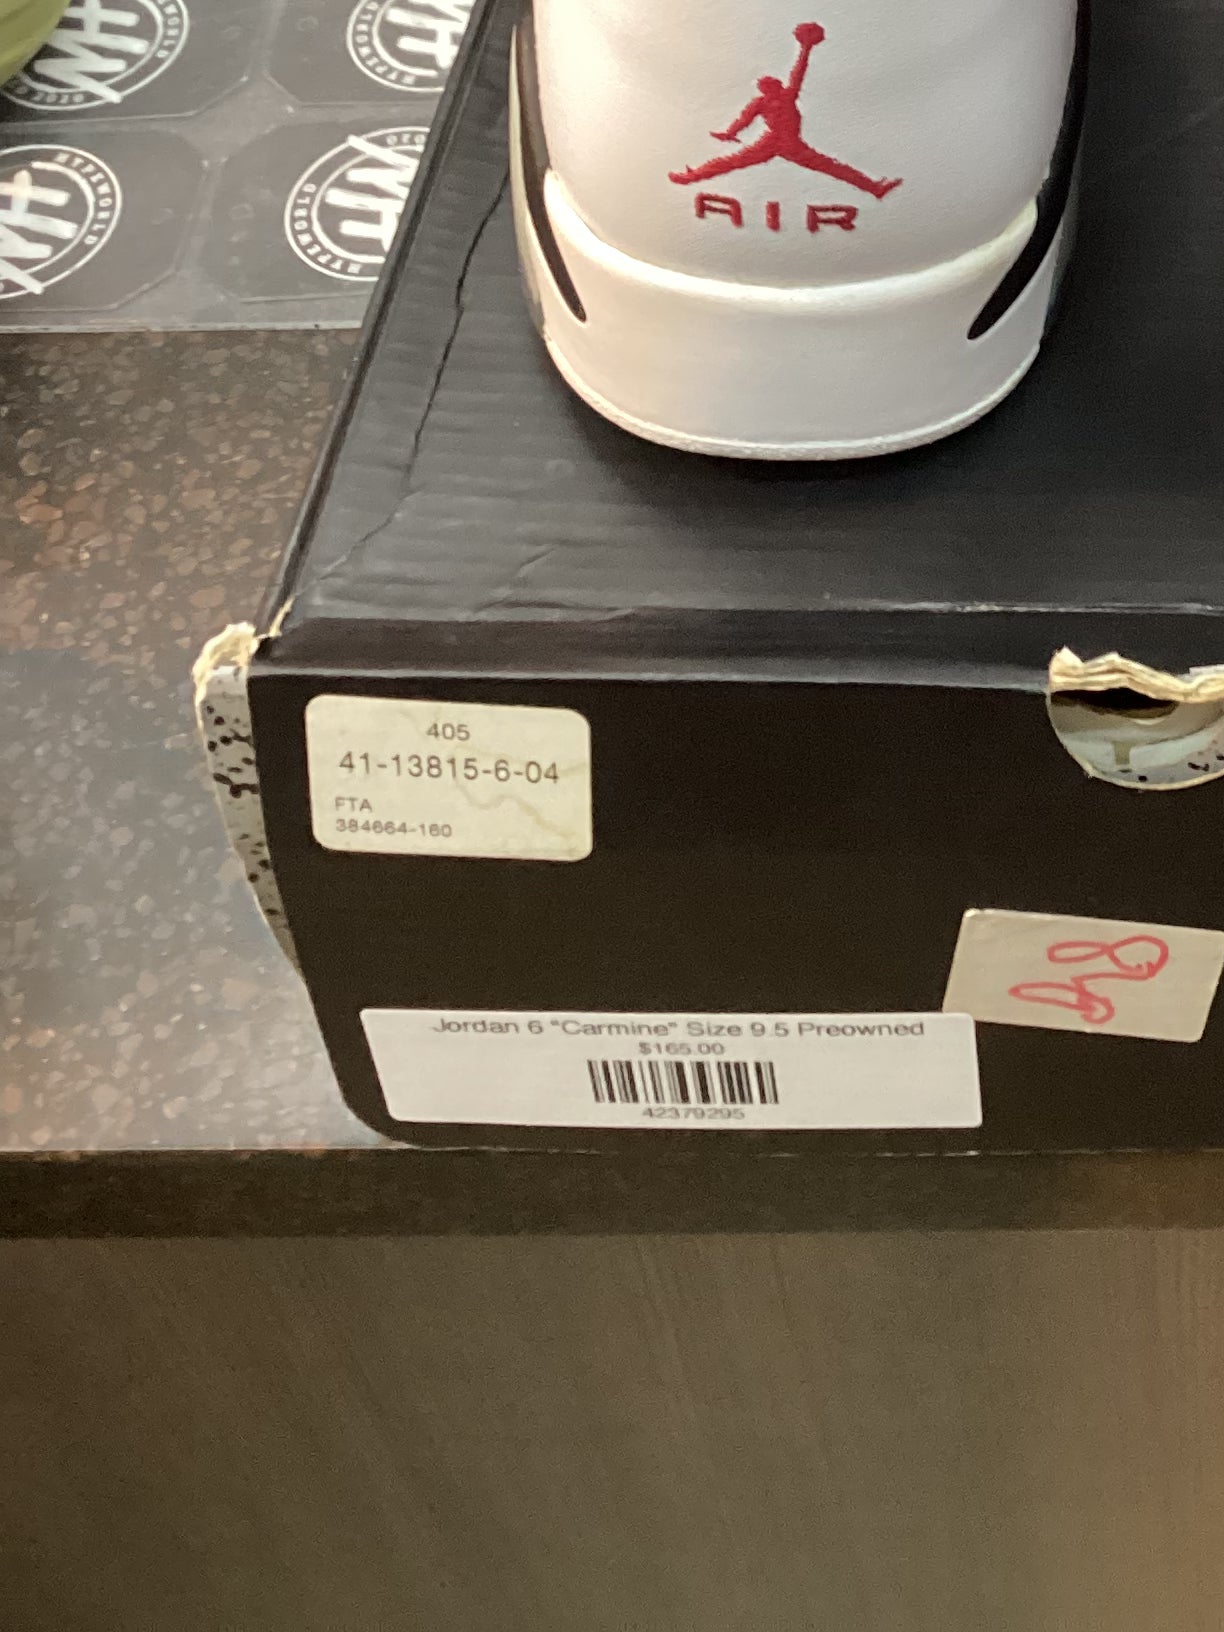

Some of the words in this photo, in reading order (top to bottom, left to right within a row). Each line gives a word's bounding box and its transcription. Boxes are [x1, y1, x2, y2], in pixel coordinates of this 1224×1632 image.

[694, 192, 859, 235] AIR
[426, 723, 471, 742] 405
[338, 751, 561, 784] 41-13815-6-04
[334, 796, 373, 813] FTA
[432, 1018, 520, 1034] Jordan
[527, 1020, 544, 1035] 6
[550, 1020, 678, 1036] "Carmine"
[686, 1021, 743, 1037] Size
[798, 1021, 926, 1037] Preowned
